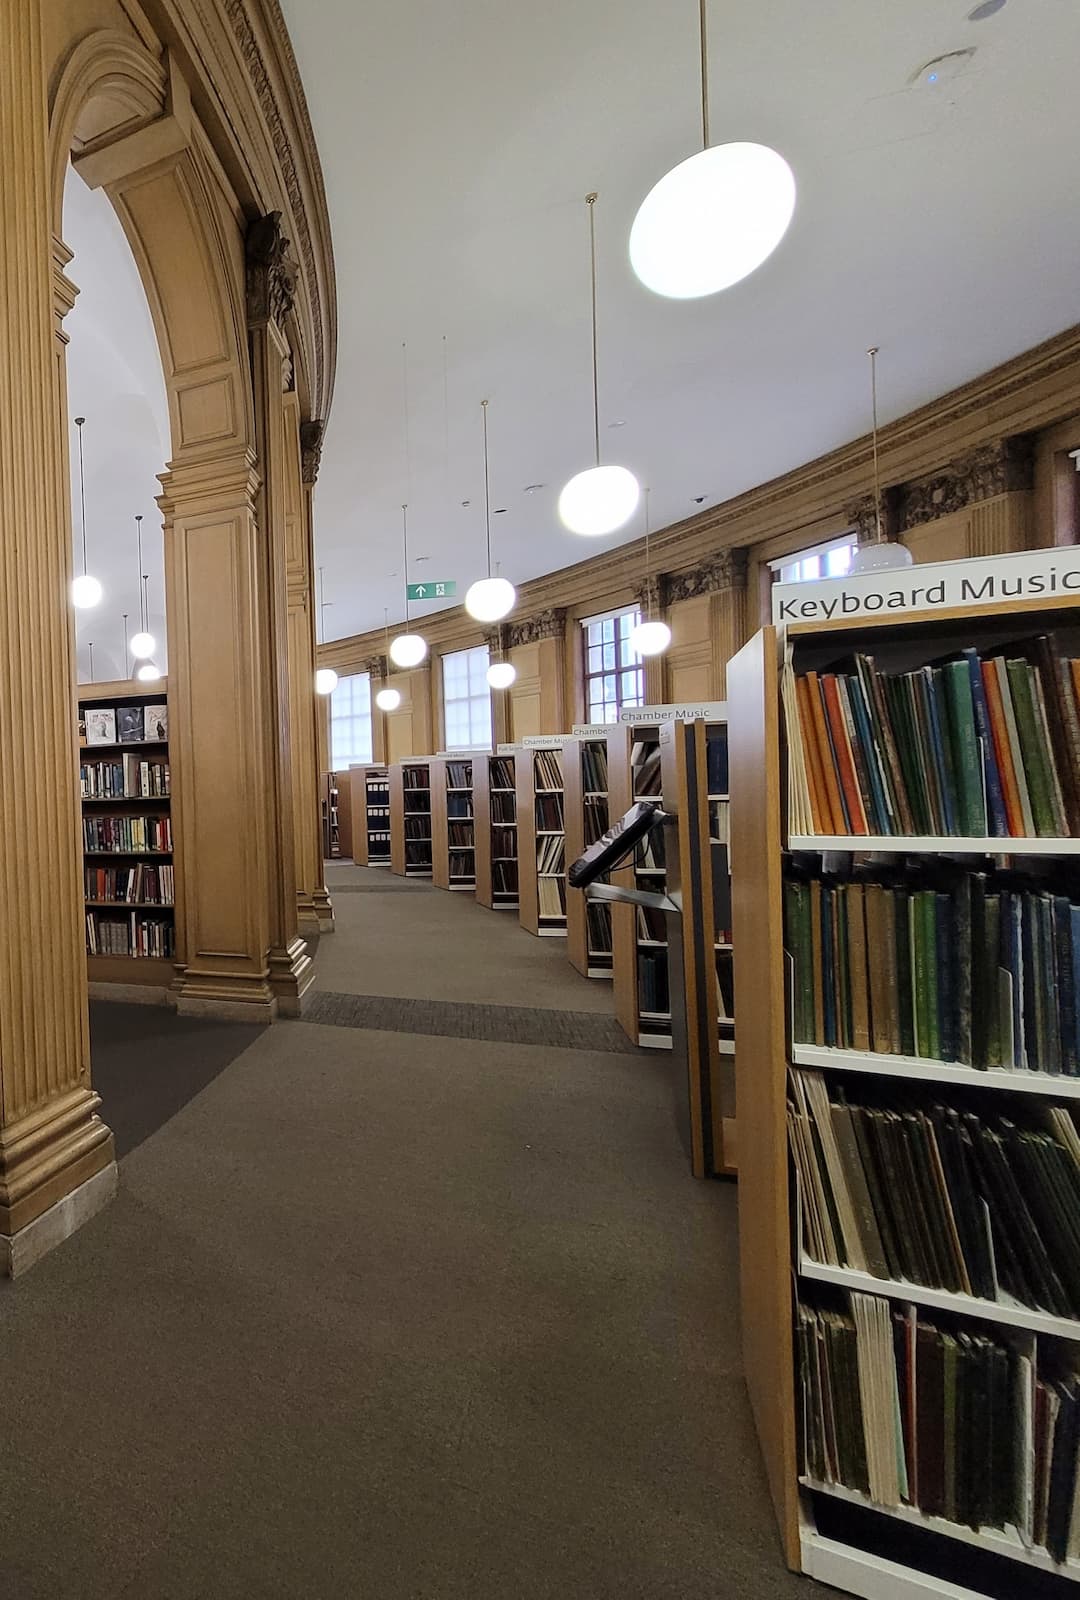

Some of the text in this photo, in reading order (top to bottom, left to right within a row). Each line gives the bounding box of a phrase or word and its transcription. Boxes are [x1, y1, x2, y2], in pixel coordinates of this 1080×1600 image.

[778, 566, 1080, 621] Keyboard Music
[621, 708, 711, 721] Chamber Music
[573, 728, 611, 736] Chambe
[524, 738, 553, 746] Chamber
